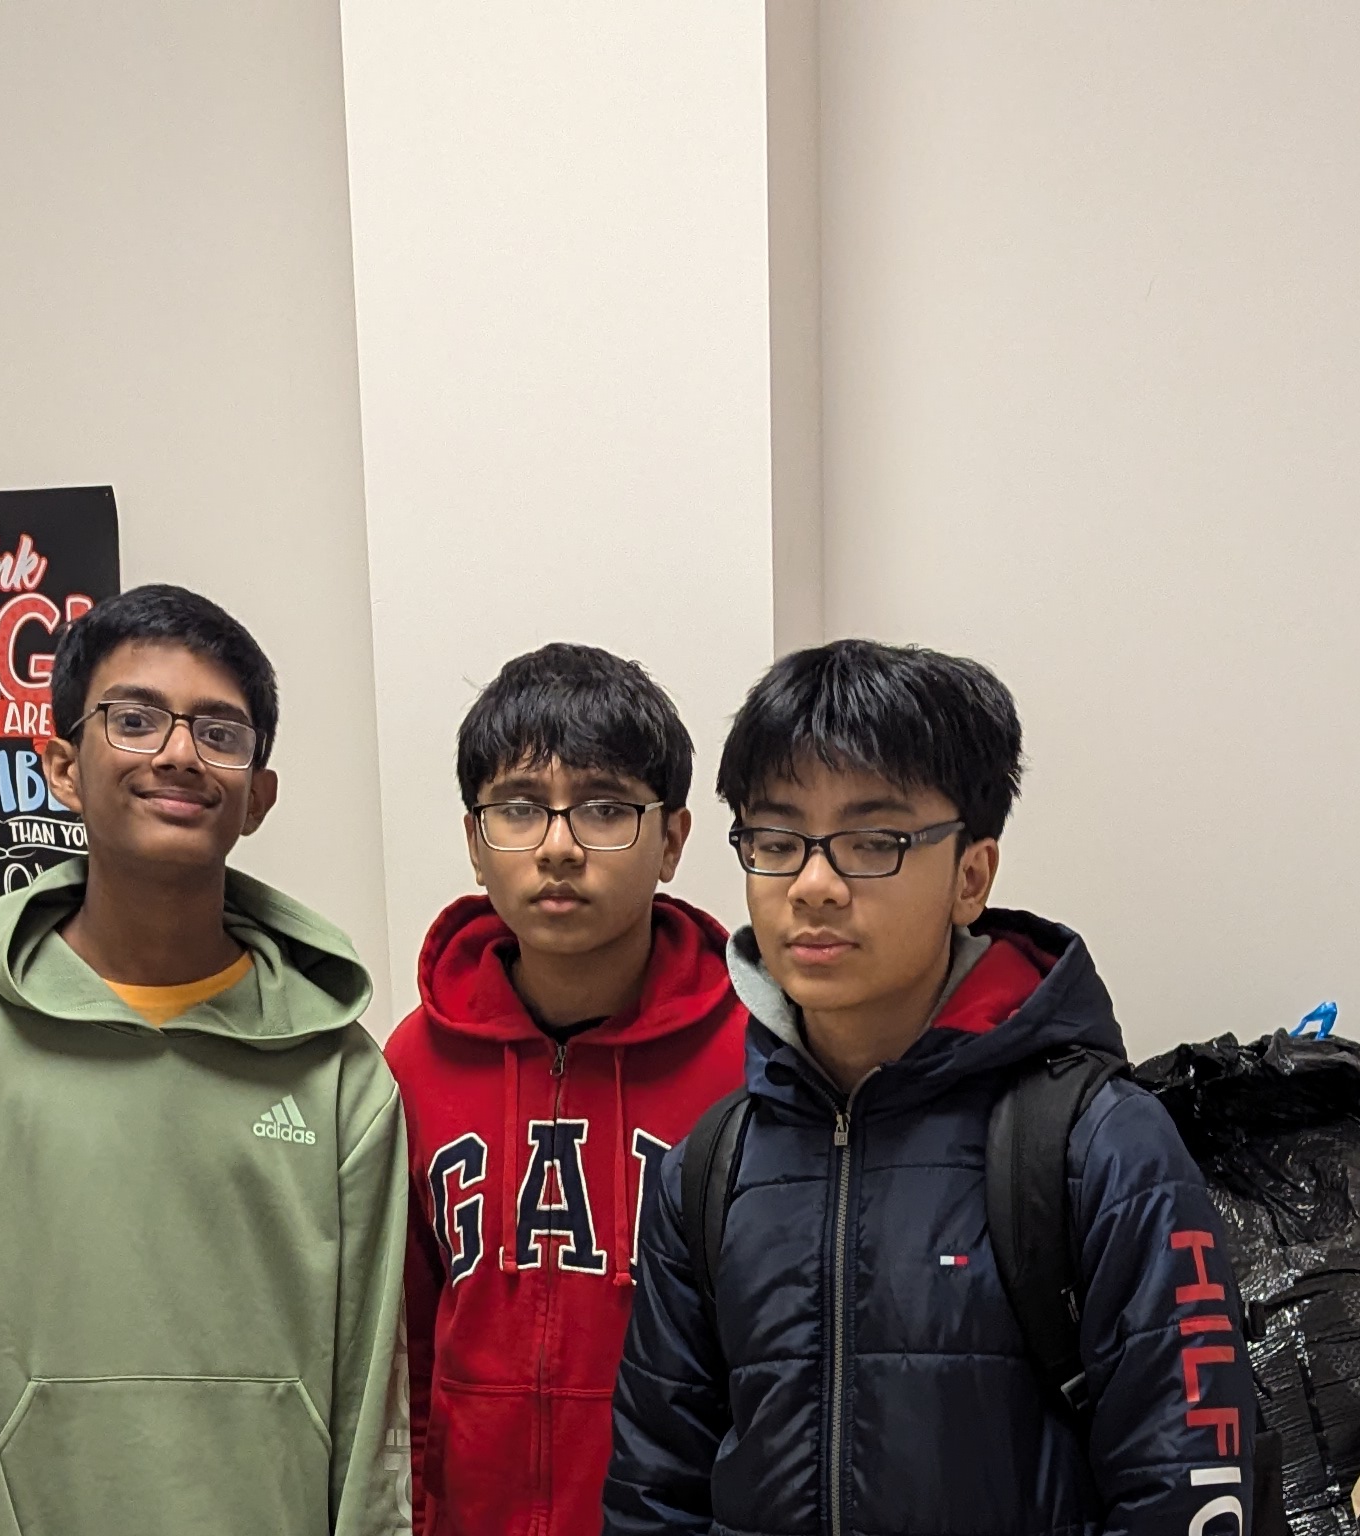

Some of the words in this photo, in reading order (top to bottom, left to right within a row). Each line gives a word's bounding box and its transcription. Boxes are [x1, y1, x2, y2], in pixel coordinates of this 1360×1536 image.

[3, 702, 52, 738] ARE
[9, 820, 55, 845] THAN
[253, 1119, 316, 1145] adidas
